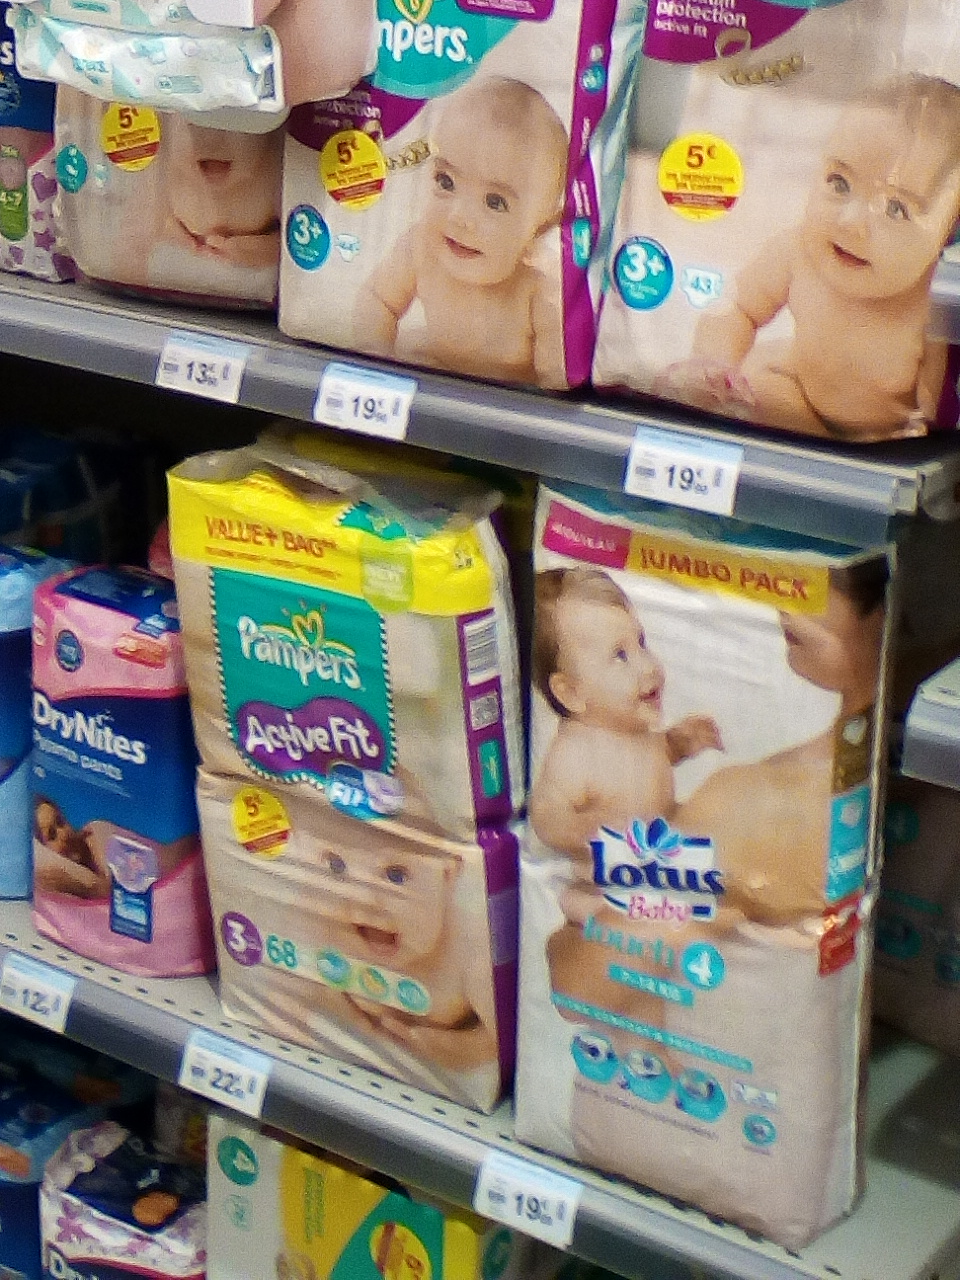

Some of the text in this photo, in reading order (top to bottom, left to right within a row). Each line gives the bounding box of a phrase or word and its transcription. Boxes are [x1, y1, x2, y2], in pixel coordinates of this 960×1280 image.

[656, 0, 746, 28] protection
[293, 213, 322, 244] 3+
[623, 243, 666, 282] 3+
[641, 547, 809, 602] JUMBO PACK
[238, 617, 363, 691] Pampers
[33, 690, 147, 764] DryNites
[265, 933, 298, 970] 68
[686, 950, 713, 987] 4
